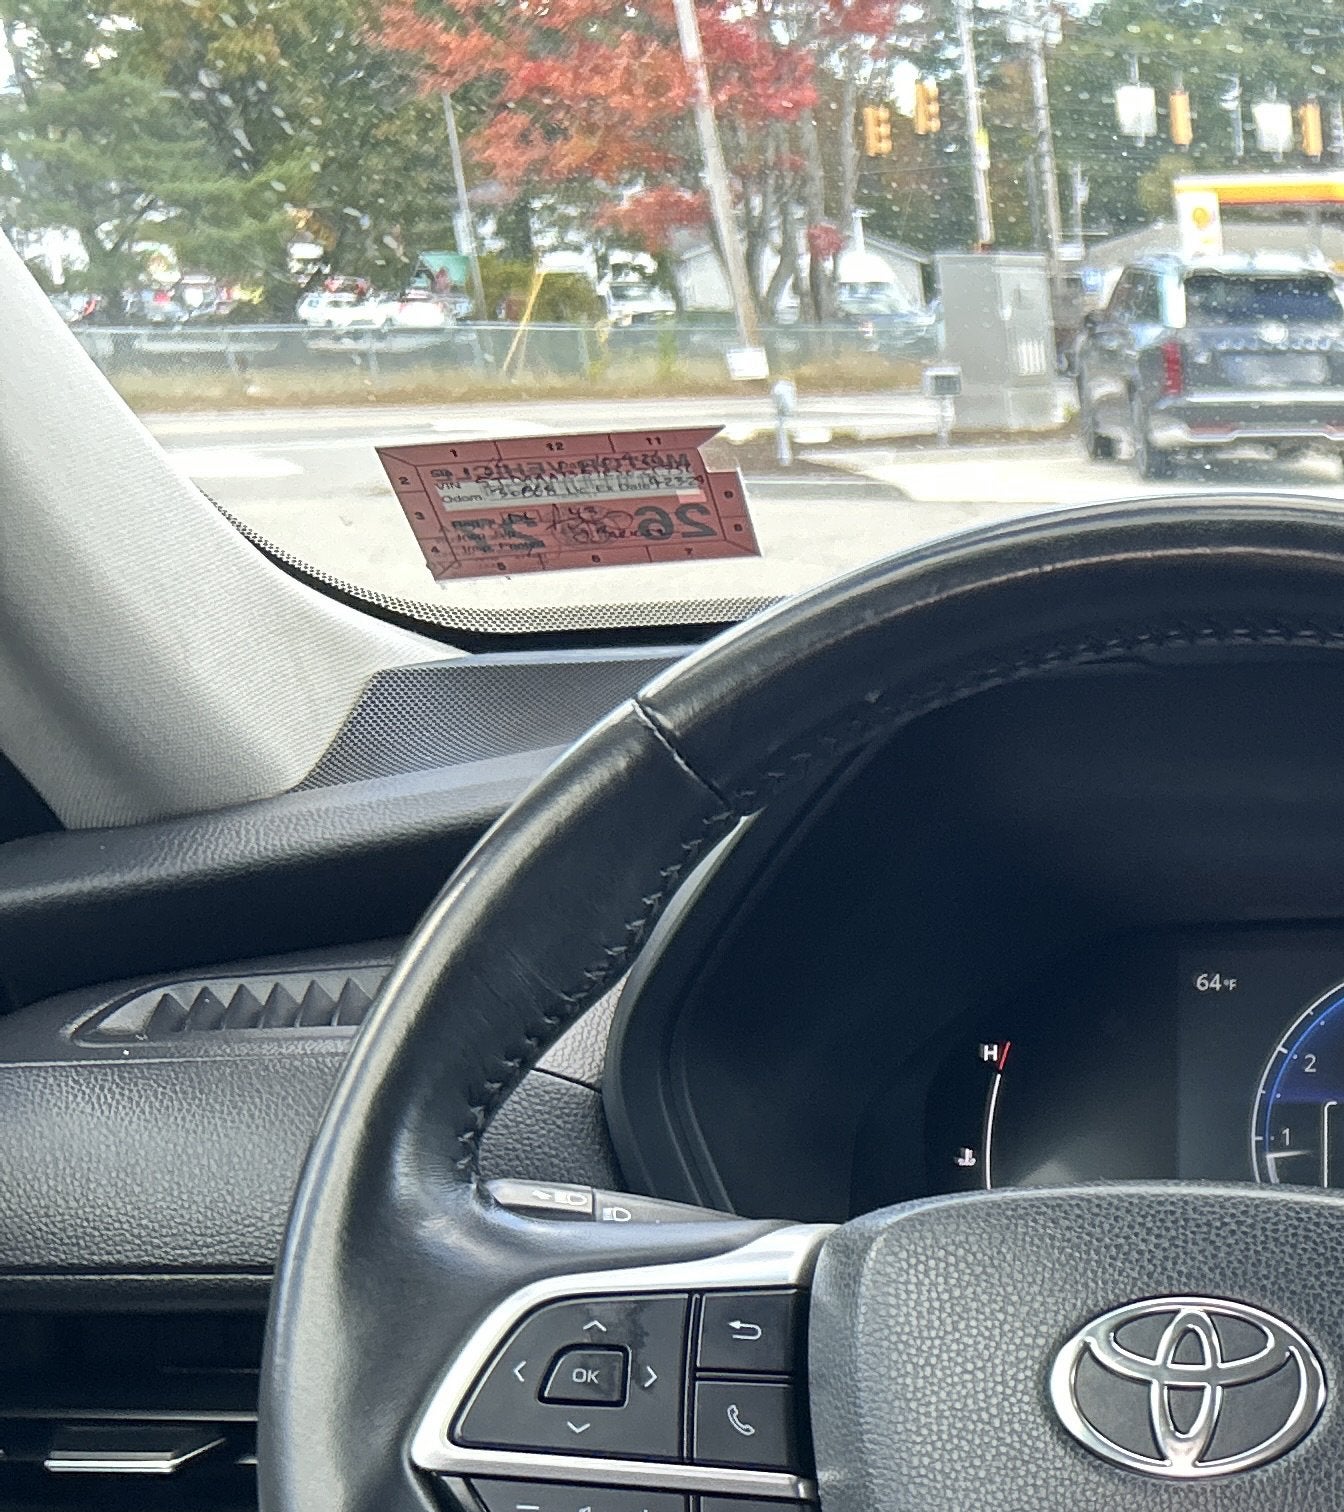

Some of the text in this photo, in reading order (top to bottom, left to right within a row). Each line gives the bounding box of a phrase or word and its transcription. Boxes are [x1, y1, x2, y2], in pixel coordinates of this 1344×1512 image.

[983, 1043, 999, 1062] H
[1303, 1053, 1317, 1073] 2
[1280, 1127, 1292, 1146] 1
[571, 1367, 601, 1385] OK
